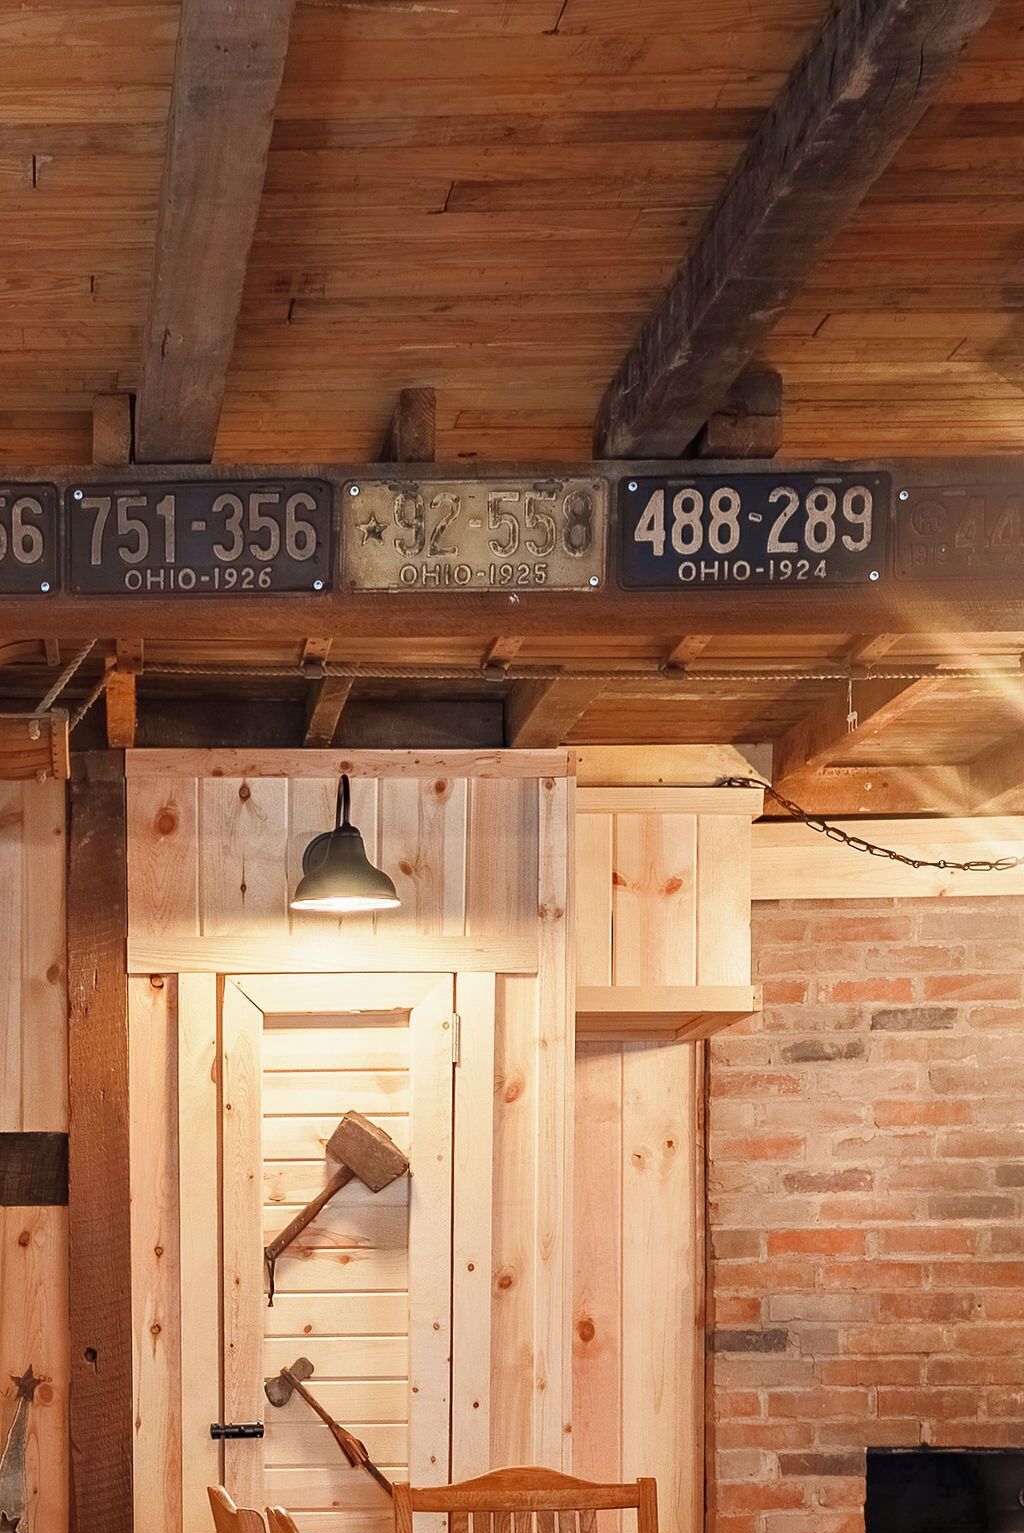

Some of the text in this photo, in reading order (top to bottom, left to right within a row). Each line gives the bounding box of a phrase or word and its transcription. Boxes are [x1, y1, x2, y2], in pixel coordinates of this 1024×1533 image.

[80, 492, 317, 565] 751-356
[393, 491, 592, 558] 92-558
[634, 486, 873, 556] 488-289
[125, 567, 273, 590] OHIO-1926
[400, 563, 547, 585] OHIO-1925
[678, 559, 828, 581] OHIO-1924
